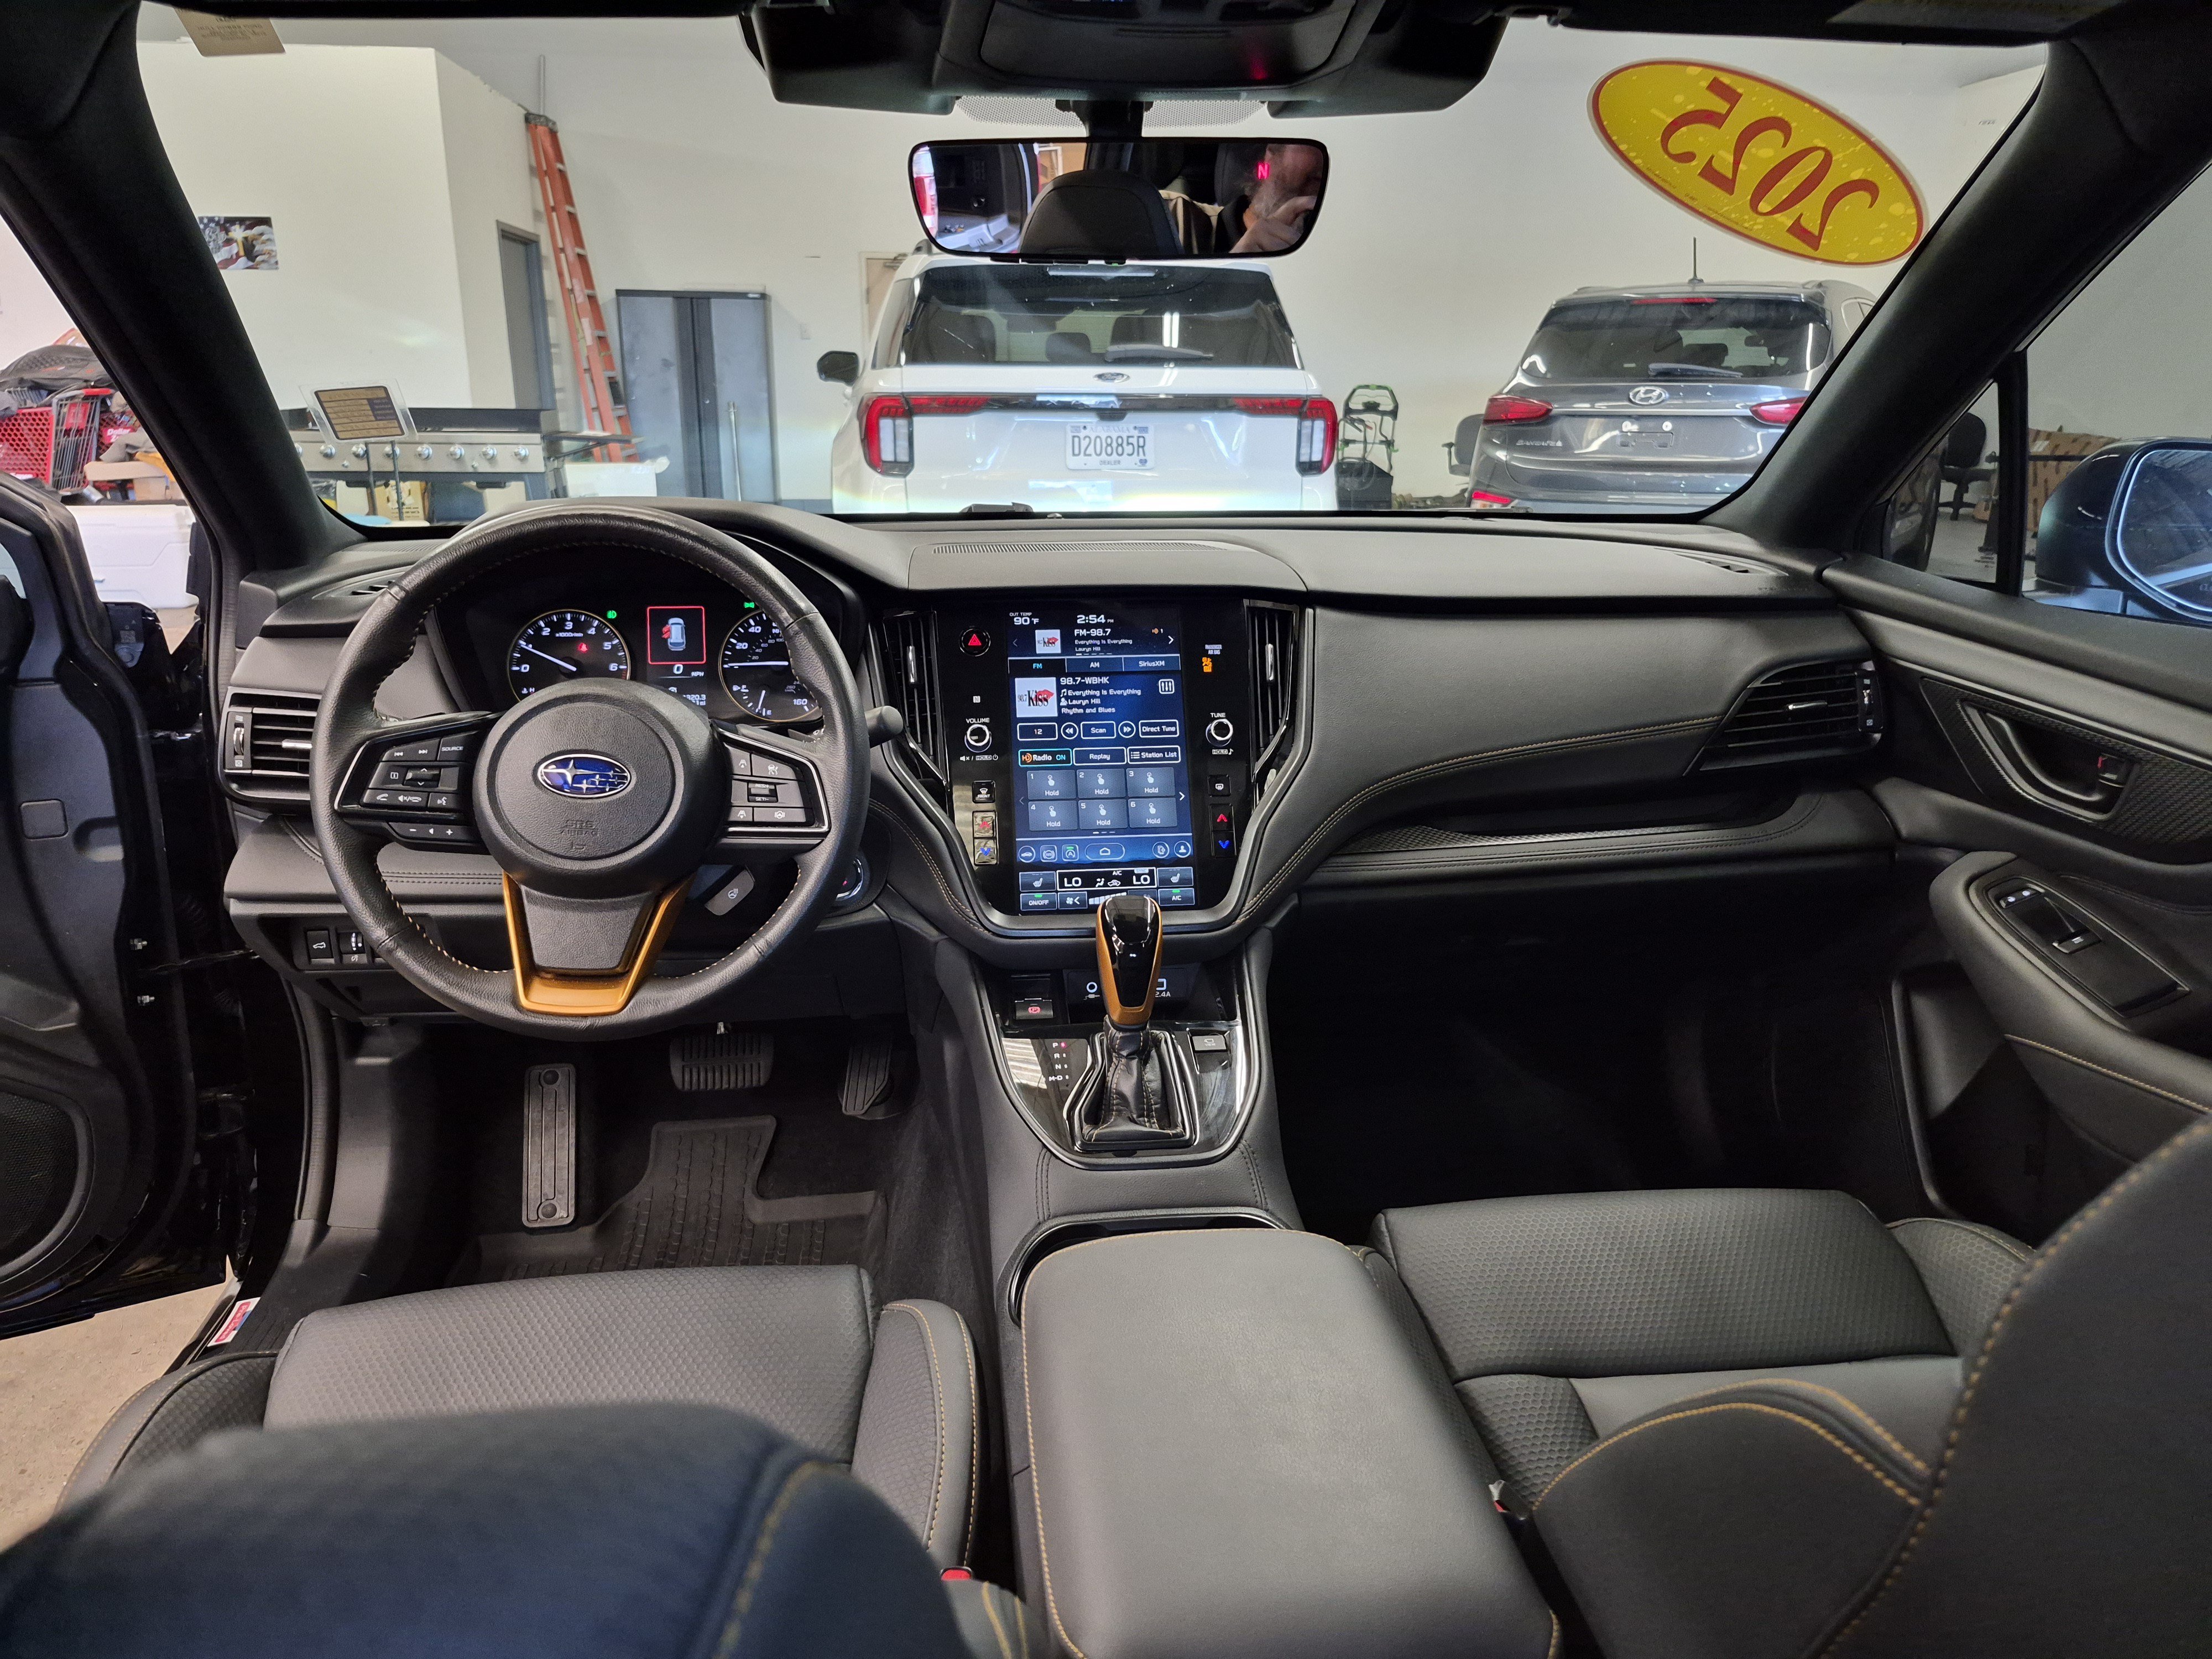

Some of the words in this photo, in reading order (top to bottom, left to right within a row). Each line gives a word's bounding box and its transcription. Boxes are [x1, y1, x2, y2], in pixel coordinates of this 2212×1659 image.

[1072, 435, 1146, 457] D20885R
[1014, 617, 1030, 625] 90
[1077, 614, 1106, 624] 2:54
[564, 622, 573, 630] 3
[603, 641, 611, 650] 5
[520, 664, 530, 672] 0
[609, 663, 618, 671] 6
[673, 664, 684, 674] 0
[1027, 690, 1049, 707] Kiss
[1063, 877, 1082, 888] LO
[1133, 875, 1150, 885] LO
